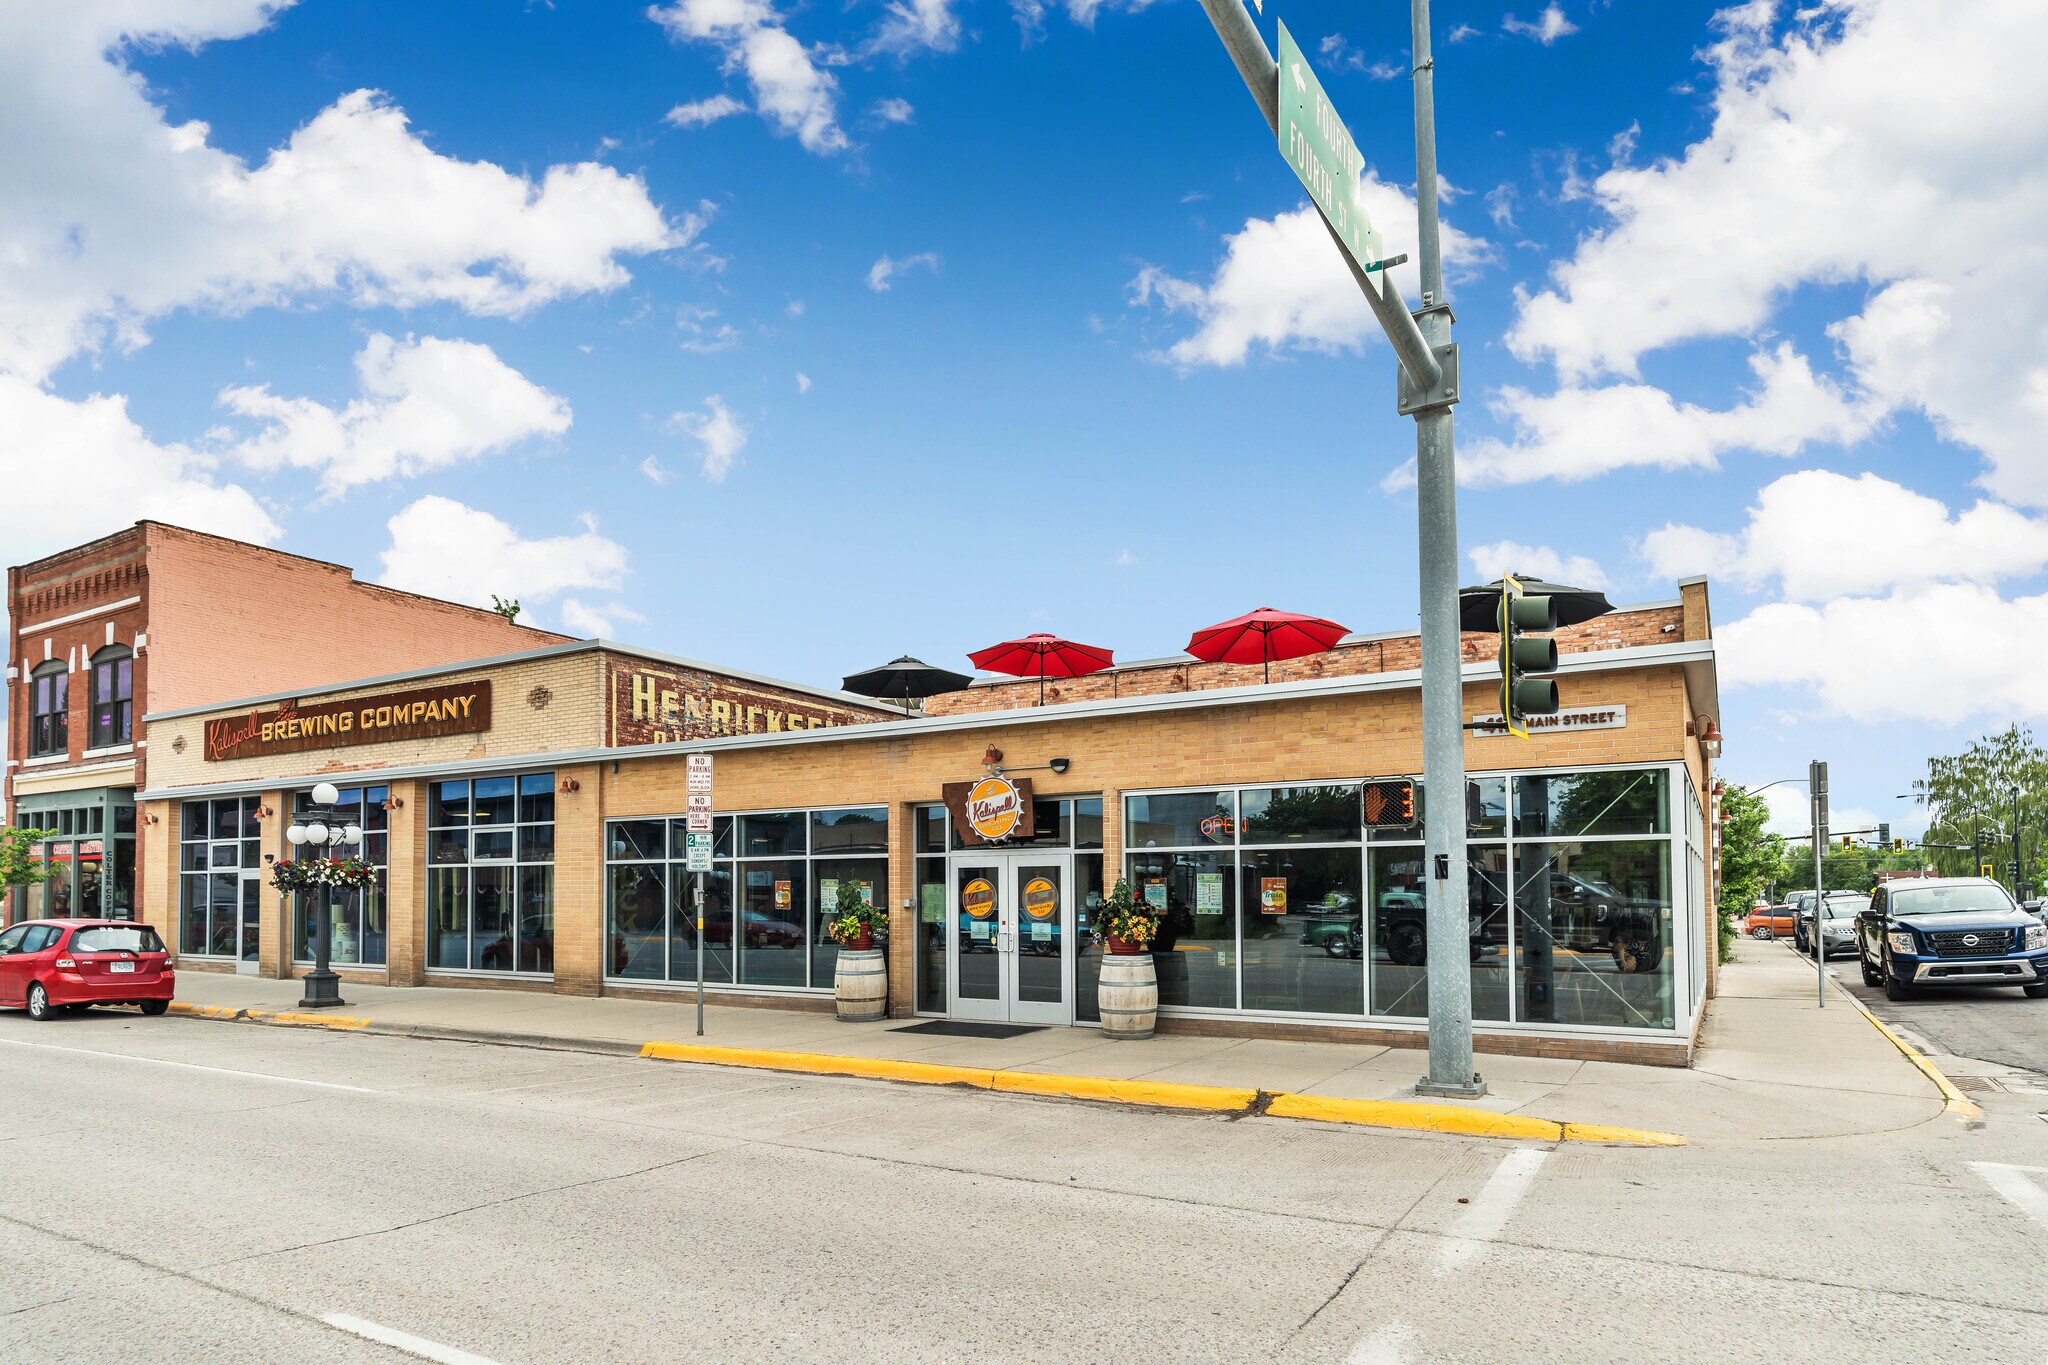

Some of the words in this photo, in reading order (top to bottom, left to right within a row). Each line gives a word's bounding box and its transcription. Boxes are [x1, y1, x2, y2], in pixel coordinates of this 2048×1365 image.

[1316, 93, 1354, 181] FOURTH
[1290, 120, 1332, 211] FOURTH
[1338, 201, 1347, 233] ST
[1353, 223, 1360, 251] W
[632, 674, 842, 737] HENRICKS
[1526, 715, 1558, 728] MAIN
[1563, 711, 1616, 726] STREET
[208, 709, 263, 760] Kalispell
[261, 711, 354, 743] BREWING
[360, 694, 477, 730] COMPANY
[688, 805, 711, 813] PARKING
[694, 797, 705, 805] NO
[972, 796, 1014, 822] Kalispell
[1402, 787, 1414, 818] 3
[980, 815, 1013, 829] BREWING
[688, 835, 695, 846] 2
[105, 850, 113, 886] COLTER
